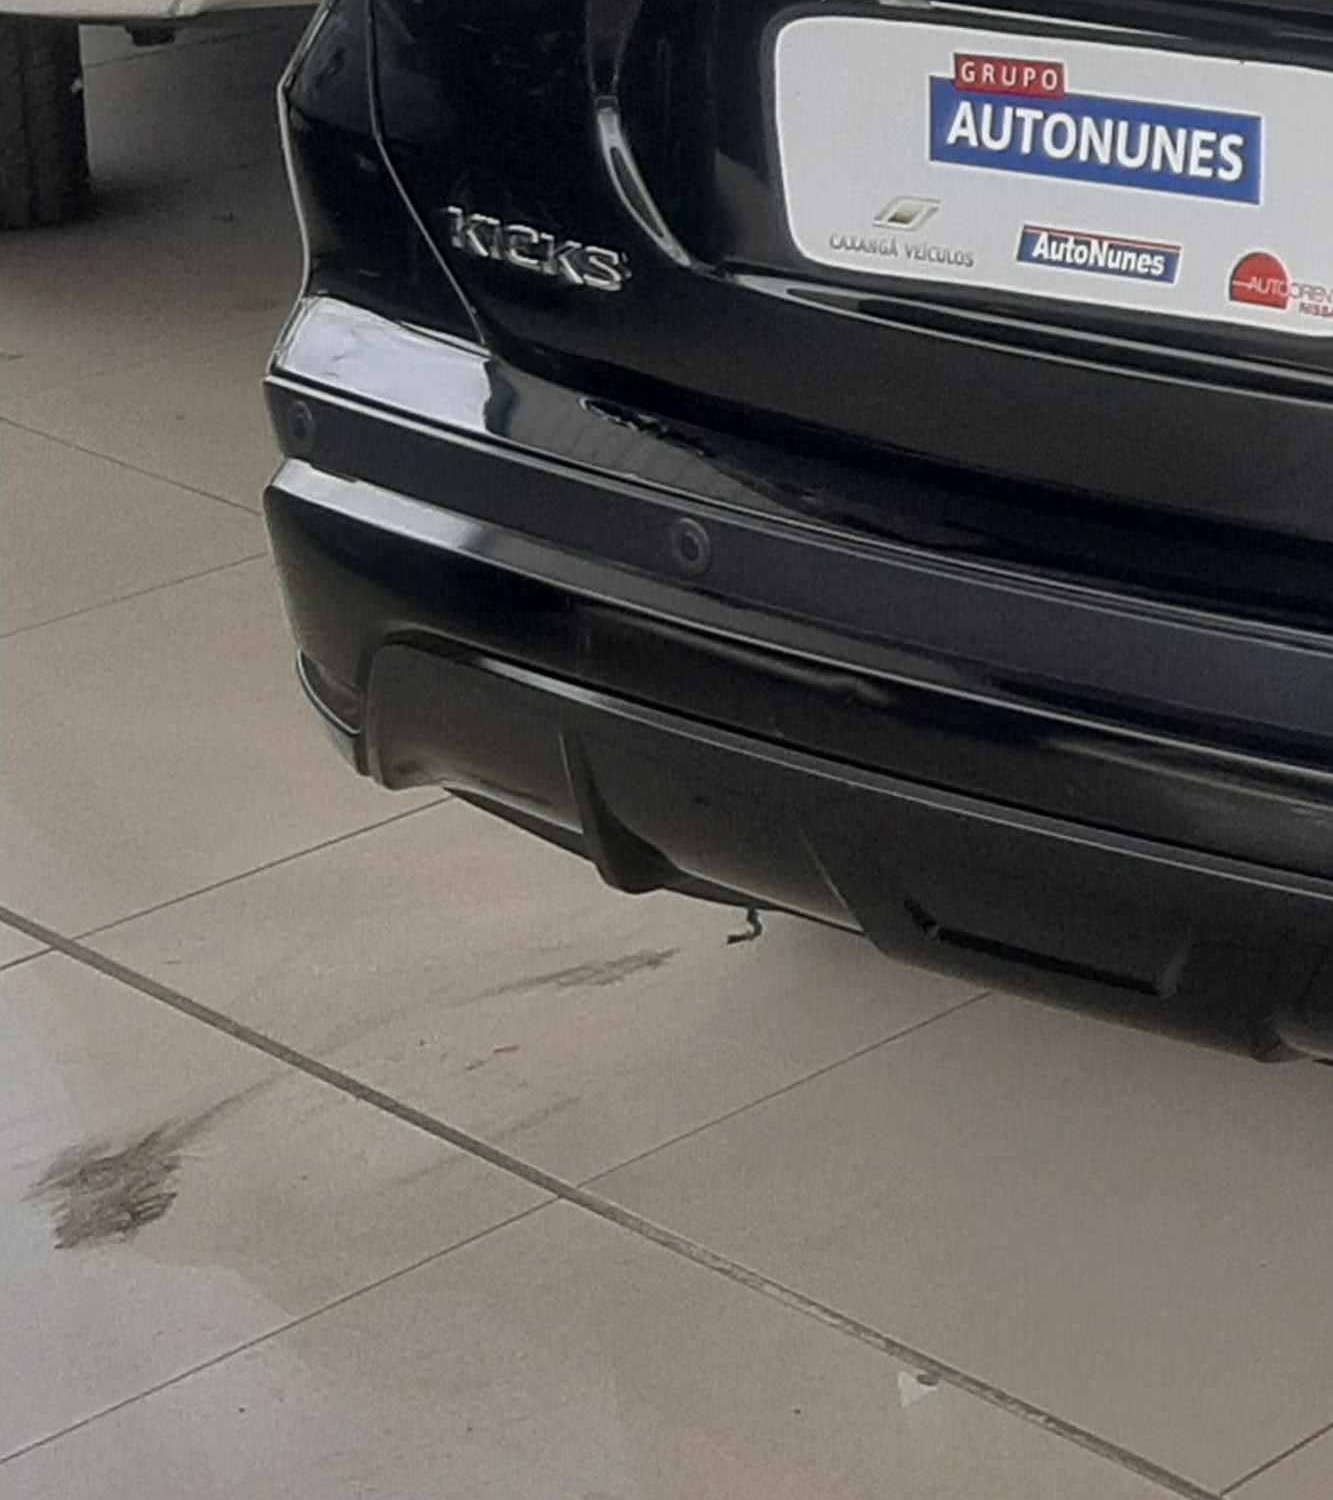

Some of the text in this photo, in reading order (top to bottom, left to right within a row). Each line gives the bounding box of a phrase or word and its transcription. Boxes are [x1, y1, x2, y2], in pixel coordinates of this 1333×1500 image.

[960, 61, 1058, 91] GRUPO
[946, 101, 1245, 182] AUTONUNES
[447, 205, 628, 292] KICKS
[1032, 231, 1166, 276] AutoNunes
